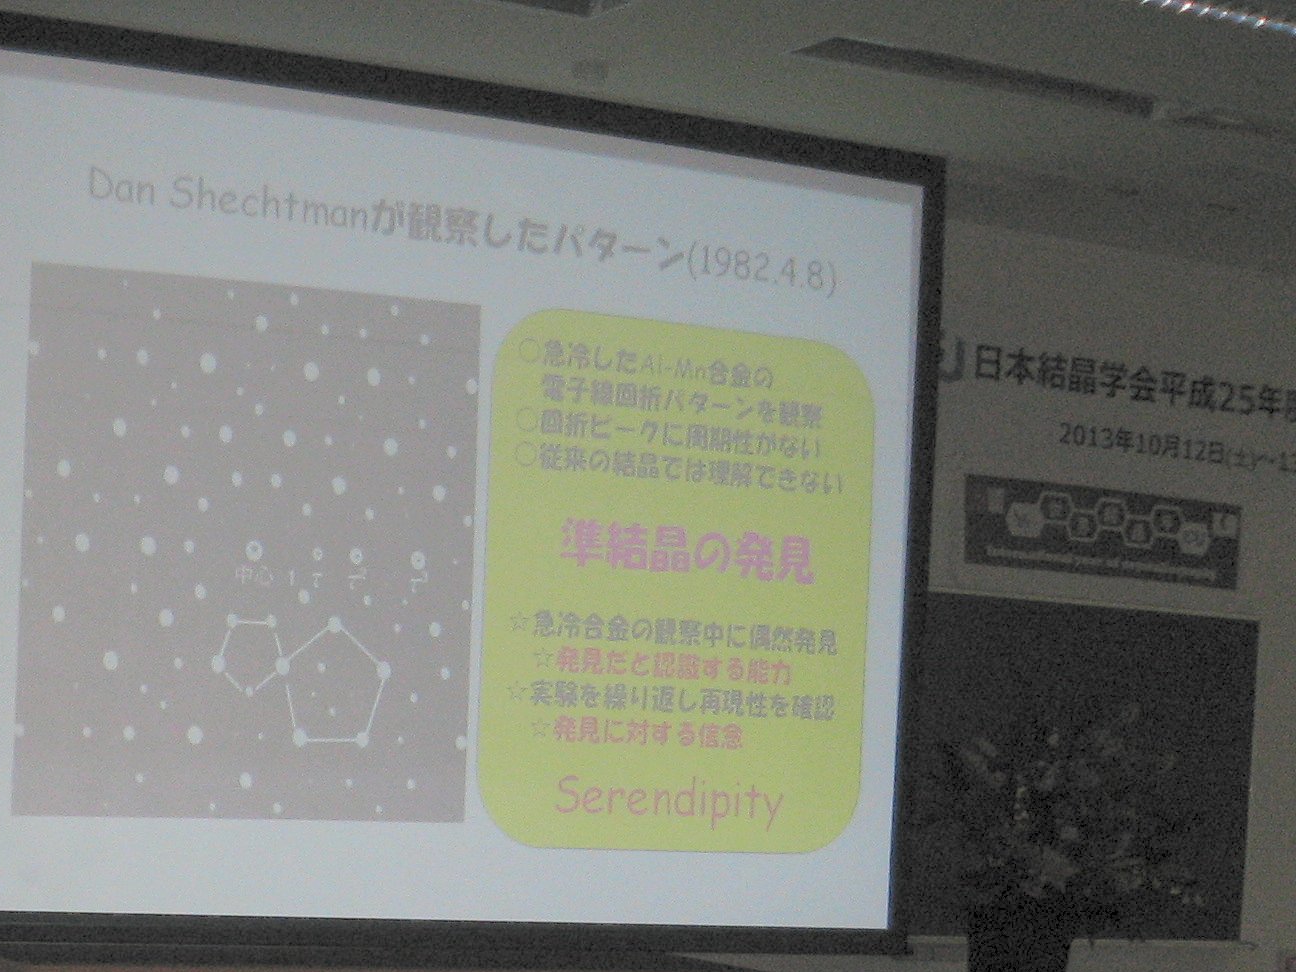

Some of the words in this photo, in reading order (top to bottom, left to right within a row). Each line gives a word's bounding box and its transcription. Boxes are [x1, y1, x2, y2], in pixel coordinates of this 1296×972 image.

[88, 165, 155, 206] Dan
[561, 517, 816, 586] 準結晶の発見
[555, 775, 784, 832] Serendipity
